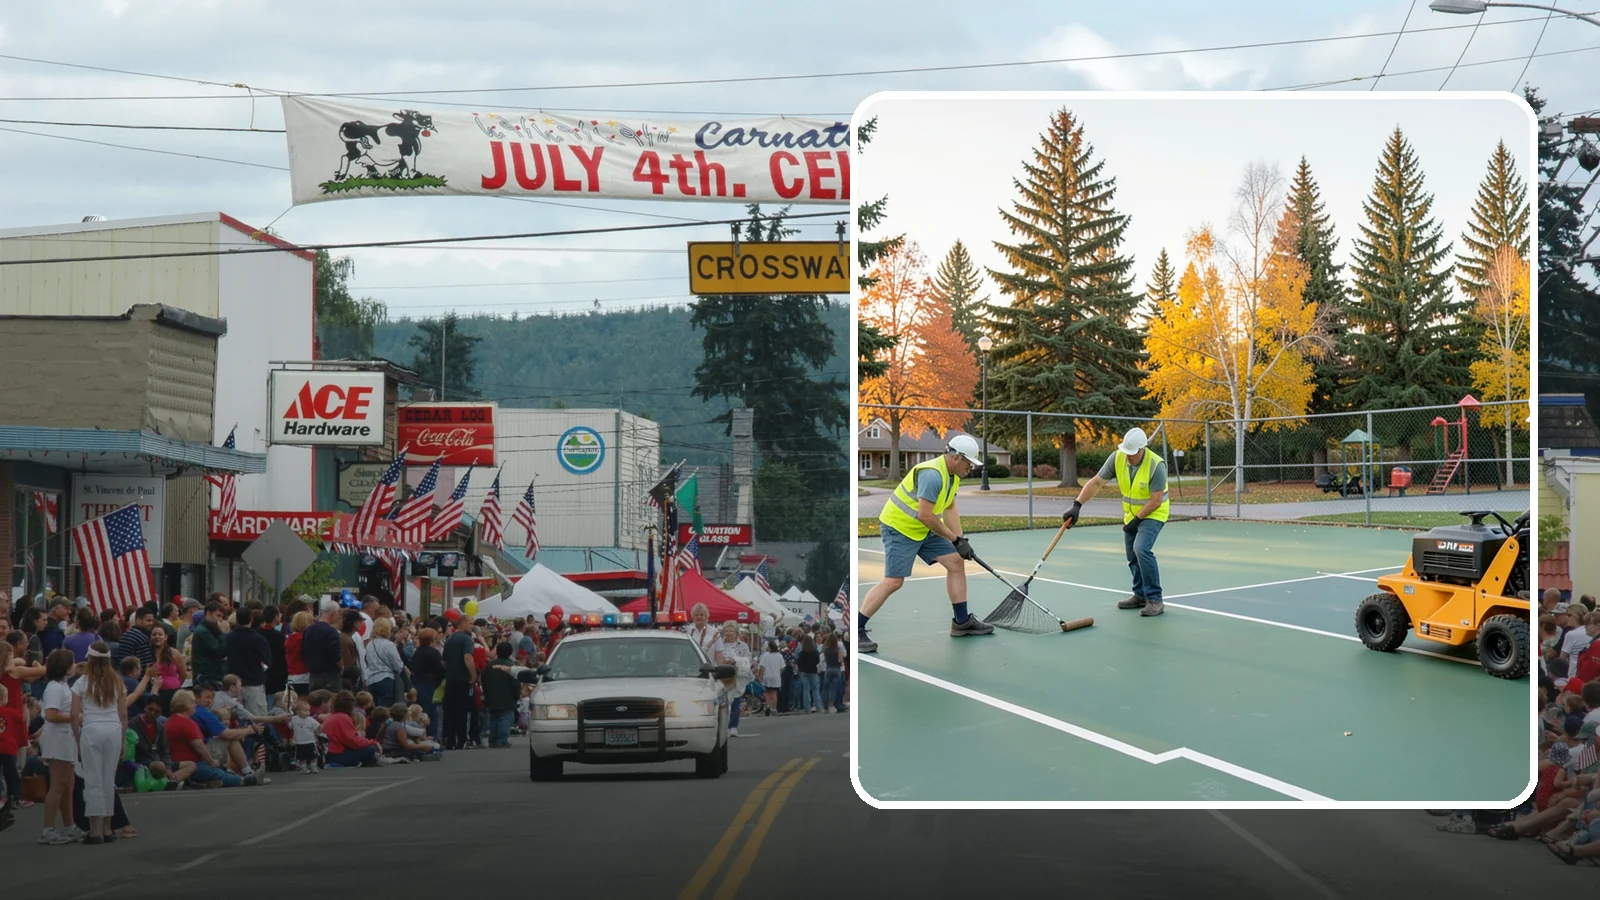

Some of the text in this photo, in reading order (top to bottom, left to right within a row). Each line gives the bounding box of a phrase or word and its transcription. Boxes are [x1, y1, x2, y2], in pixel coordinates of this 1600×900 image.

[481, 141, 605, 192] JULY
[632, 150, 746, 198] 4th.
[697, 254, 850, 280] CROSSWA
[282, 380, 373, 420] ACE
[405, 409, 485, 422] CEDAR LOG
[283, 421, 371, 436] Hardware
[353, 467, 386, 480] Simpl
[83, 485, 155, 495] St. Vincent de Paul
[81, 503, 154, 522] THRT
[688, 526, 741, 535] CRNATION
[699, 535, 730, 543] GLASS
